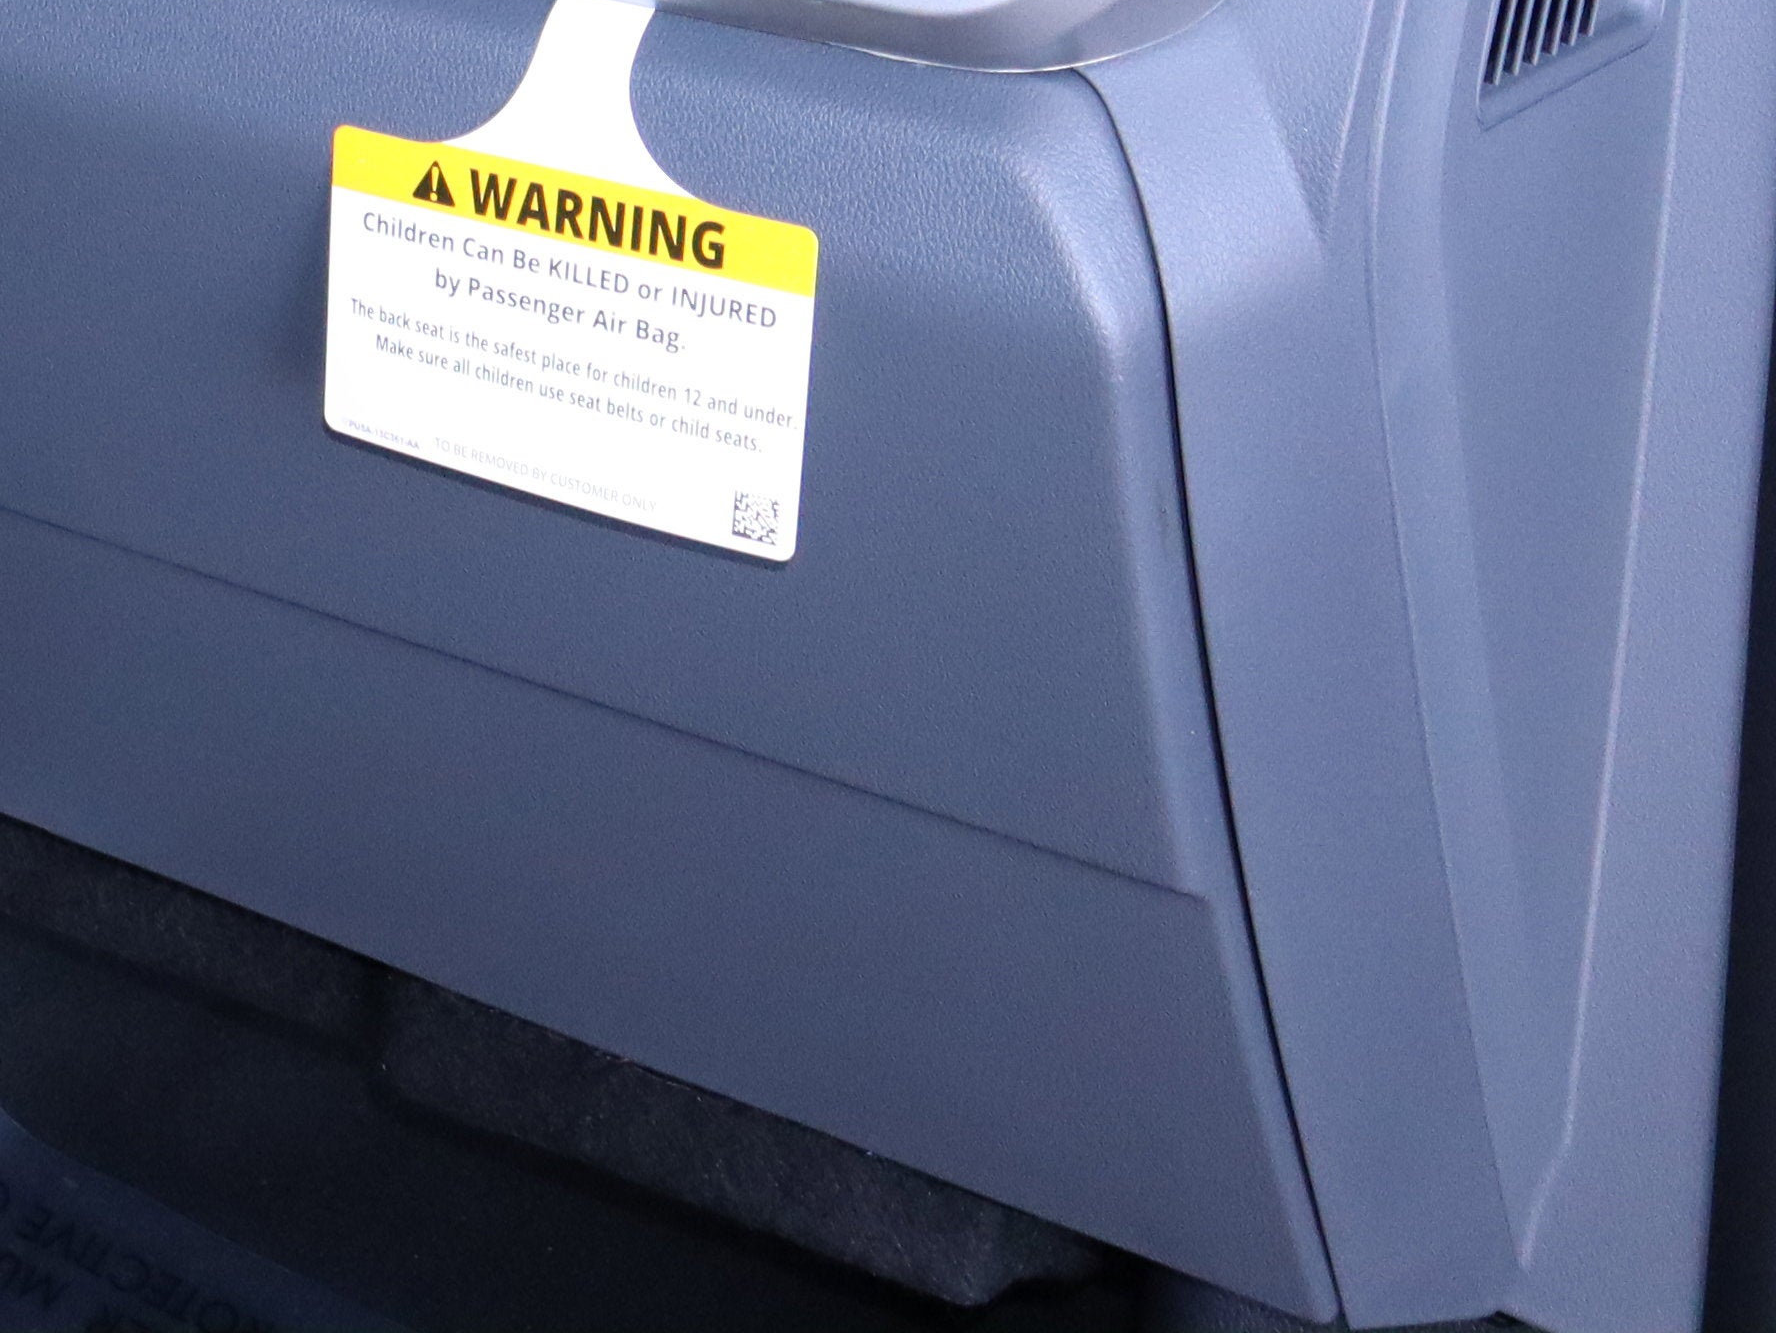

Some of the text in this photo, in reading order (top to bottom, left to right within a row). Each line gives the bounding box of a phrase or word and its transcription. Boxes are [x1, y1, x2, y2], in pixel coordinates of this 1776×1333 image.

[363, 211, 776, 328] Children Can Be KILLED or INJURED
[470, 168, 724, 268] WARNING
[350, 297, 796, 429] The back seat is the safest place for children 12 and under.
[435, 266, 685, 353] by Passenger Air Bag.
[375, 333, 761, 452] Make sure all children use seat belts or child seats.
